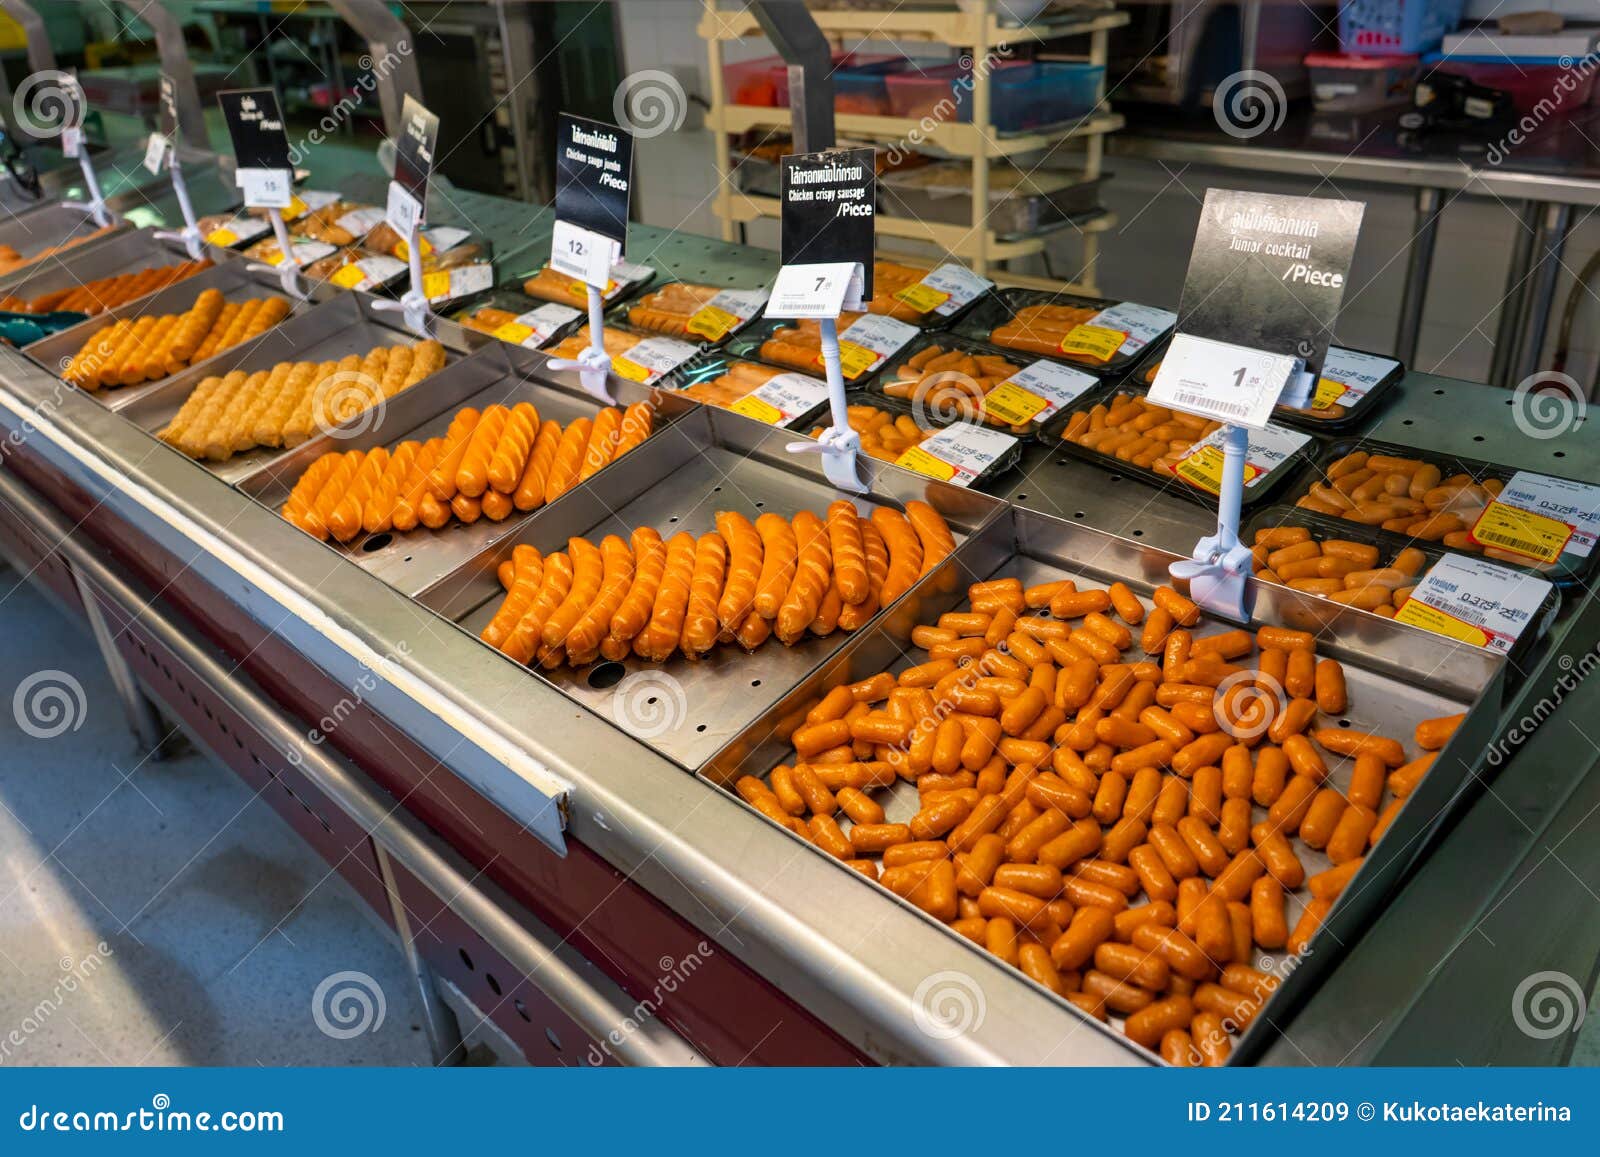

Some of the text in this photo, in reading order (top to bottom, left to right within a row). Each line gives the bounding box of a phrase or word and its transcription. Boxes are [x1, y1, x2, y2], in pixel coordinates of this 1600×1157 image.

[599, 171, 628, 191] /Piece
[788, 187, 865, 203] Chicken crispy sausage
[836, 202, 873, 217] /Piece
[1229, 236, 1312, 261] Junior cocktail
[814, 277, 826, 292] 7
[1281, 262, 1344, 289] /Piece
